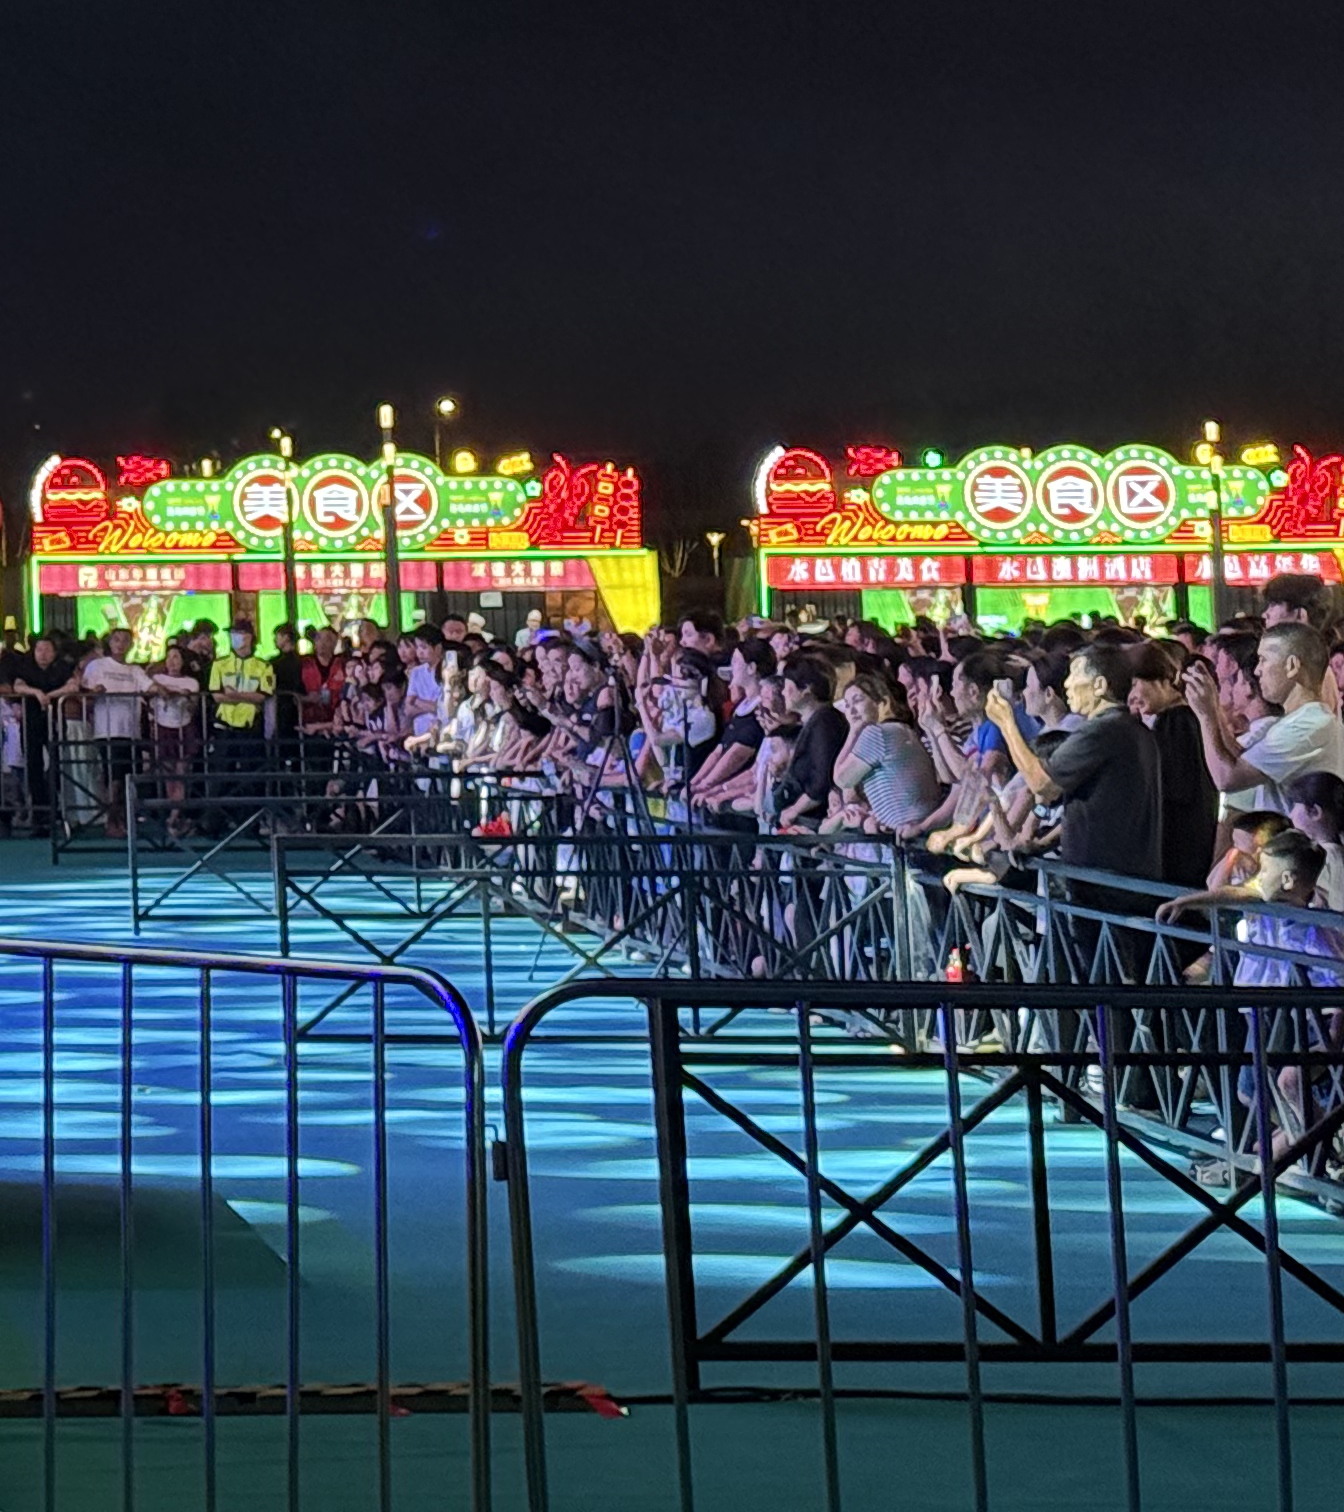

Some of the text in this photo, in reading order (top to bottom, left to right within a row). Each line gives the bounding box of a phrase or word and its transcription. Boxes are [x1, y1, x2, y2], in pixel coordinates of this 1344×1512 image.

[242, 481, 429, 522] 美食区
[974, 474, 1165, 515] 美食区
[88, 521, 216, 553] Welcome
[816, 512, 949, 545] Welcome
